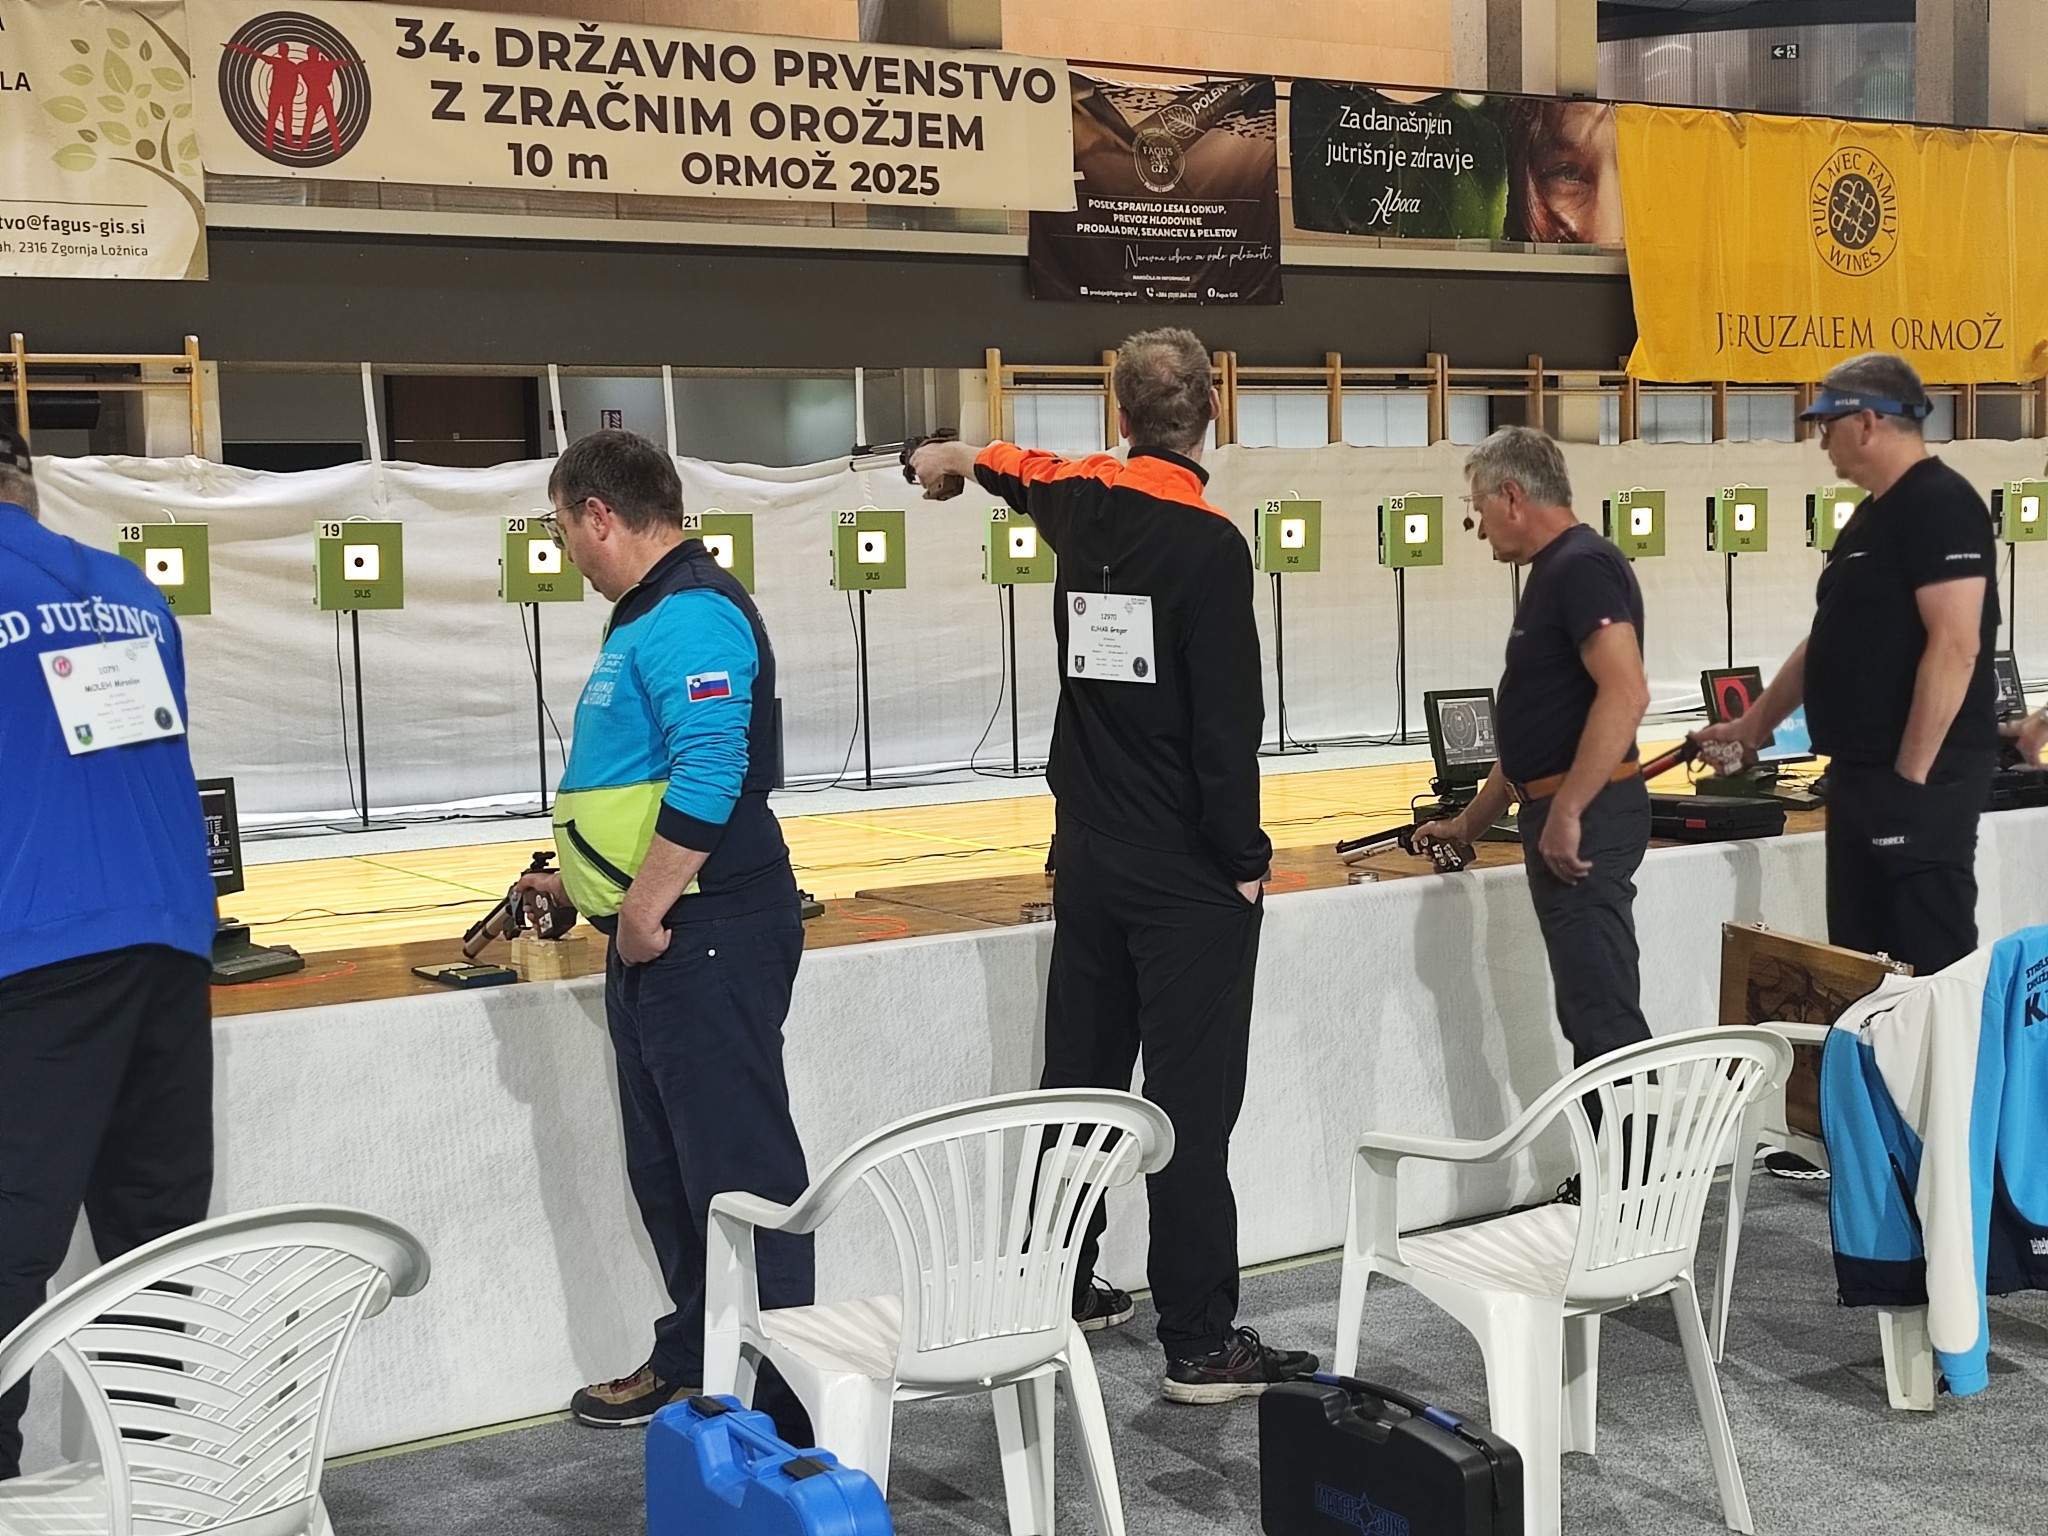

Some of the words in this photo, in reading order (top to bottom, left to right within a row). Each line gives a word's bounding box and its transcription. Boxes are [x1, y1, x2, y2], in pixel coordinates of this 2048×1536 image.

[395, 17, 480, 63] 34.
[494, 22, 757, 84] DRŽAVNO
[773, 49, 1056, 104] PRVENSTVO
[430, 79, 466, 121] Z
[482, 80, 731, 137] ZRAČNIM
[750, 98, 984, 151] OROŽJEM
[1339, 105, 1361, 129] Za
[1325, 138, 1407, 172] jutrišnje
[1410, 146, 1474, 175] zdravje
[507, 142, 553, 178] 10
[568, 152, 608, 180] m
[681, 150, 837, 191] ORMOŽ
[849, 161, 940, 196] 2025
[1812, 153, 1862, 237] PUKLAVEC
[1866, 161, 1897, 240] FAMILY
[1163, 203, 1185, 213] LESA
[1367, 186, 1421, 225] Aboca
[1113, 213, 1148, 224] PREVOZ
[1149, 215, 1203, 226] HLODOVINE
[1076, 223, 1121, 235] PRODAJA
[1121, 225, 1141, 237] DRV,
[1141, 227, 1189, 238] SEKANCEV
[1189, 229, 1197, 238] &
[1197, 228, 1238, 238] PELETOV
[19, 241, 48, 254] 2316
[51, 242, 98, 257] Zgornja
[101, 244, 149, 257] Ložnica
[1830, 245, 1882, 271] WINES
[1715, 312, 1876, 354] JERUZALEM
[1891, 311, 2004, 350] ORMOŽ
[1723, 488, 1735, 499] 29
[1823, 487, 1834, 497] 30
[2012, 483, 2021, 492] 32
[1391, 498, 1403, 510] 26
[1618, 492, 1630, 503] 28
[1266, 501, 1280, 513] 25
[839, 512, 855, 524] 22
[992, 508, 1007, 521] 23
[508, 519, 526, 532] 20
[683, 515, 699, 529] 21
[121, 527, 140, 540] 18
[322, 524, 340, 537] 19
[354, 589, 372, 599] SIUS
